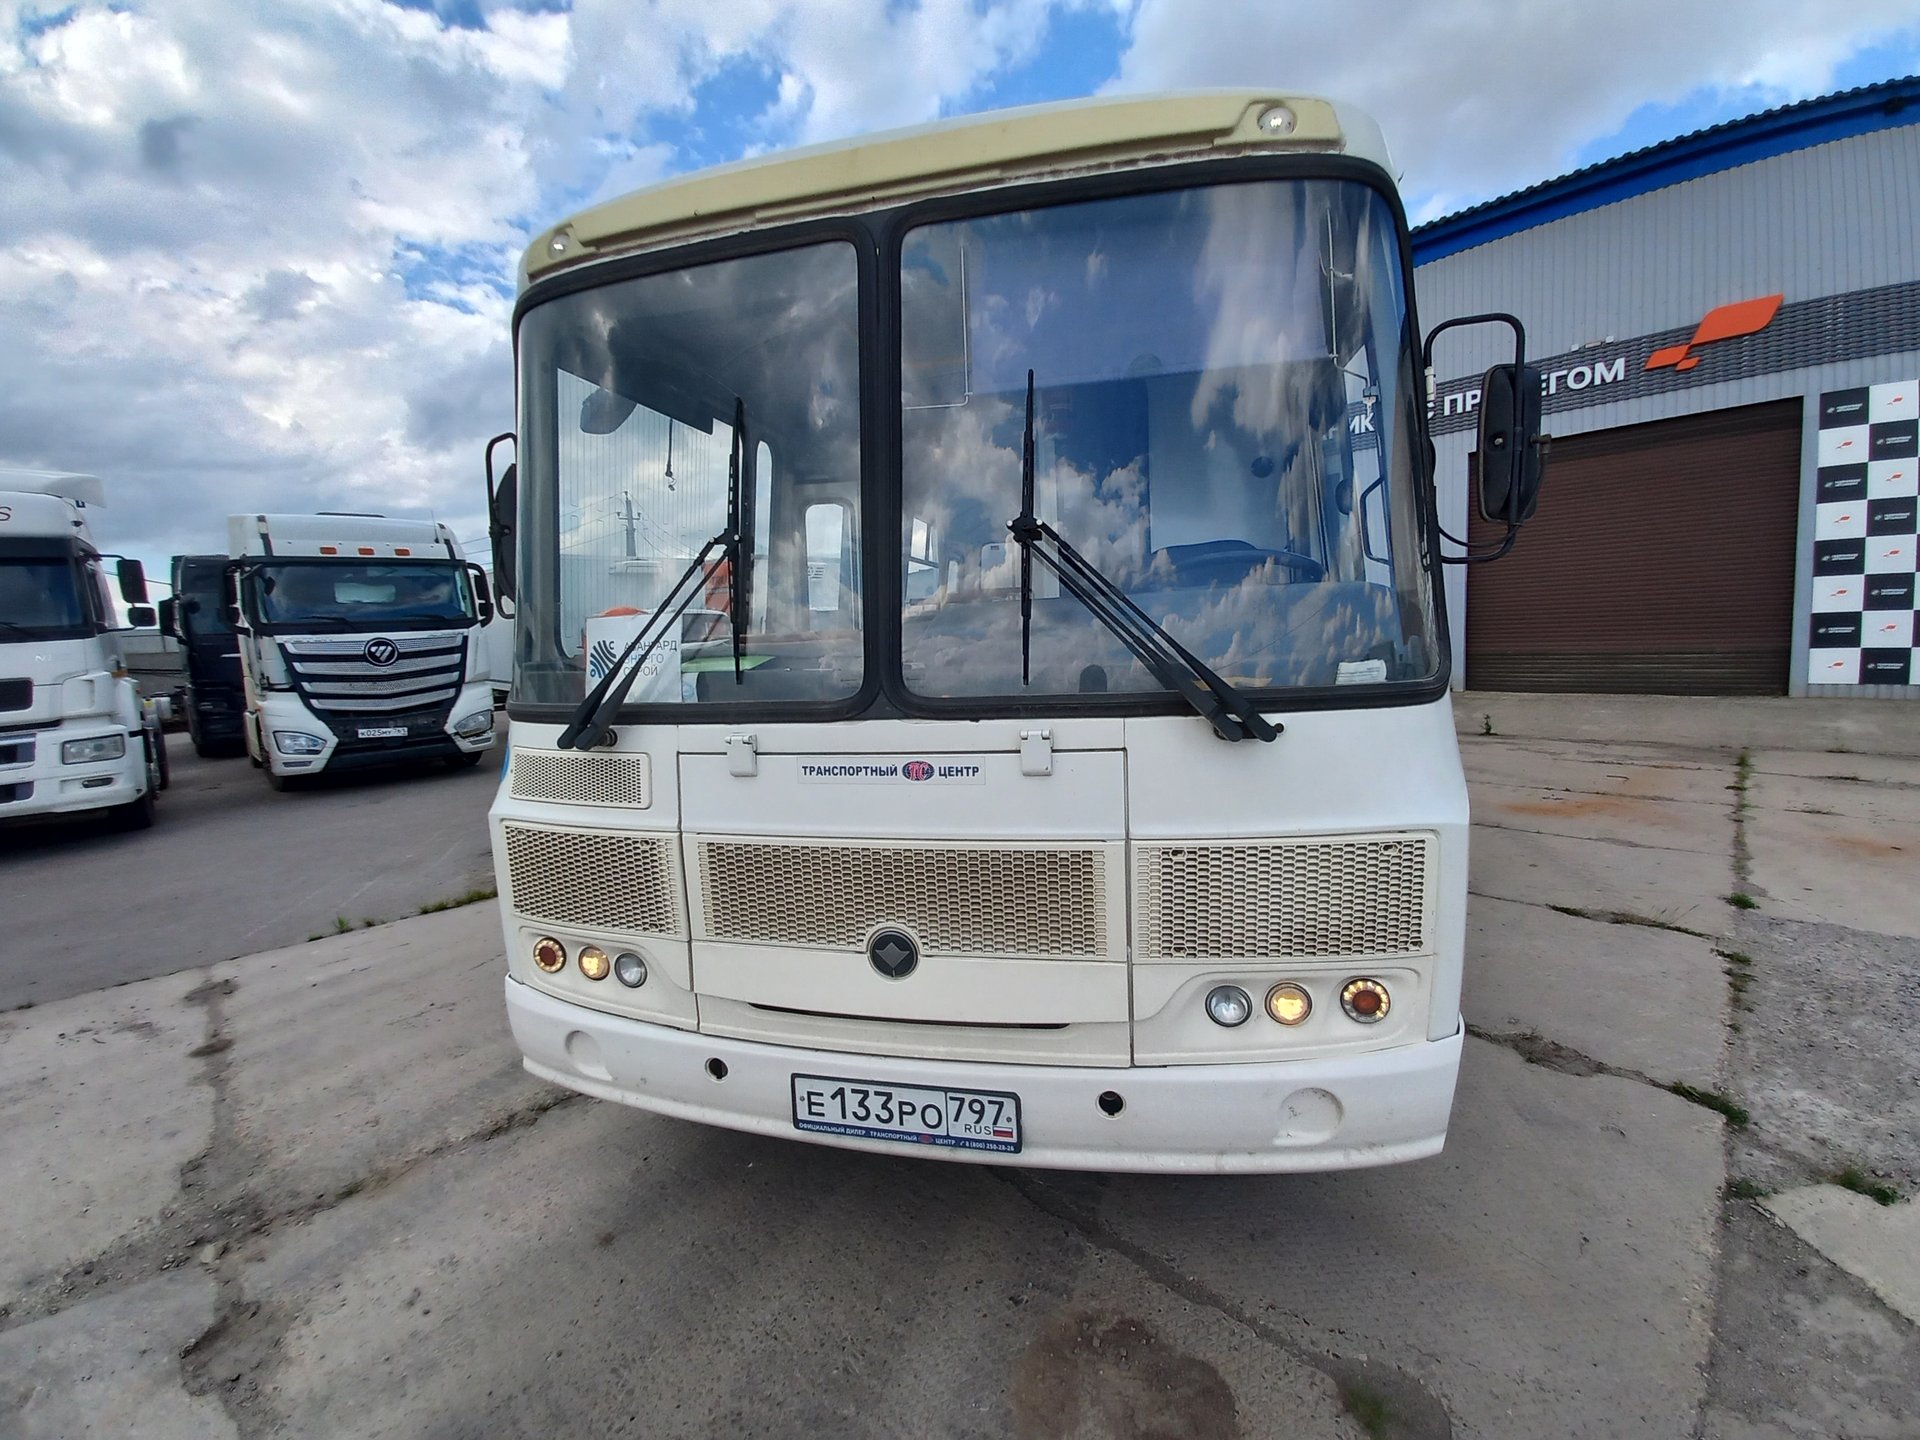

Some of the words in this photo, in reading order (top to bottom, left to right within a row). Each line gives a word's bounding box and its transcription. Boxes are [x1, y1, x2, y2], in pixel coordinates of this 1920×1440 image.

[801, 763, 898, 777] ТРАНСПОРТНЫЙ
[938, 766, 979, 779] ЦЕНТР
[798, 1122, 845, 1135] ОФИЦИАЛЬНЫЙ
[845, 1127, 866, 1137] ДИЛЕР
[869, 1130, 917, 1142] ТРАНСПОРТНЫЙ
[935, 1138, 956, 1146] ЦЕНТР
[964, 1124, 992, 1136] RUS
